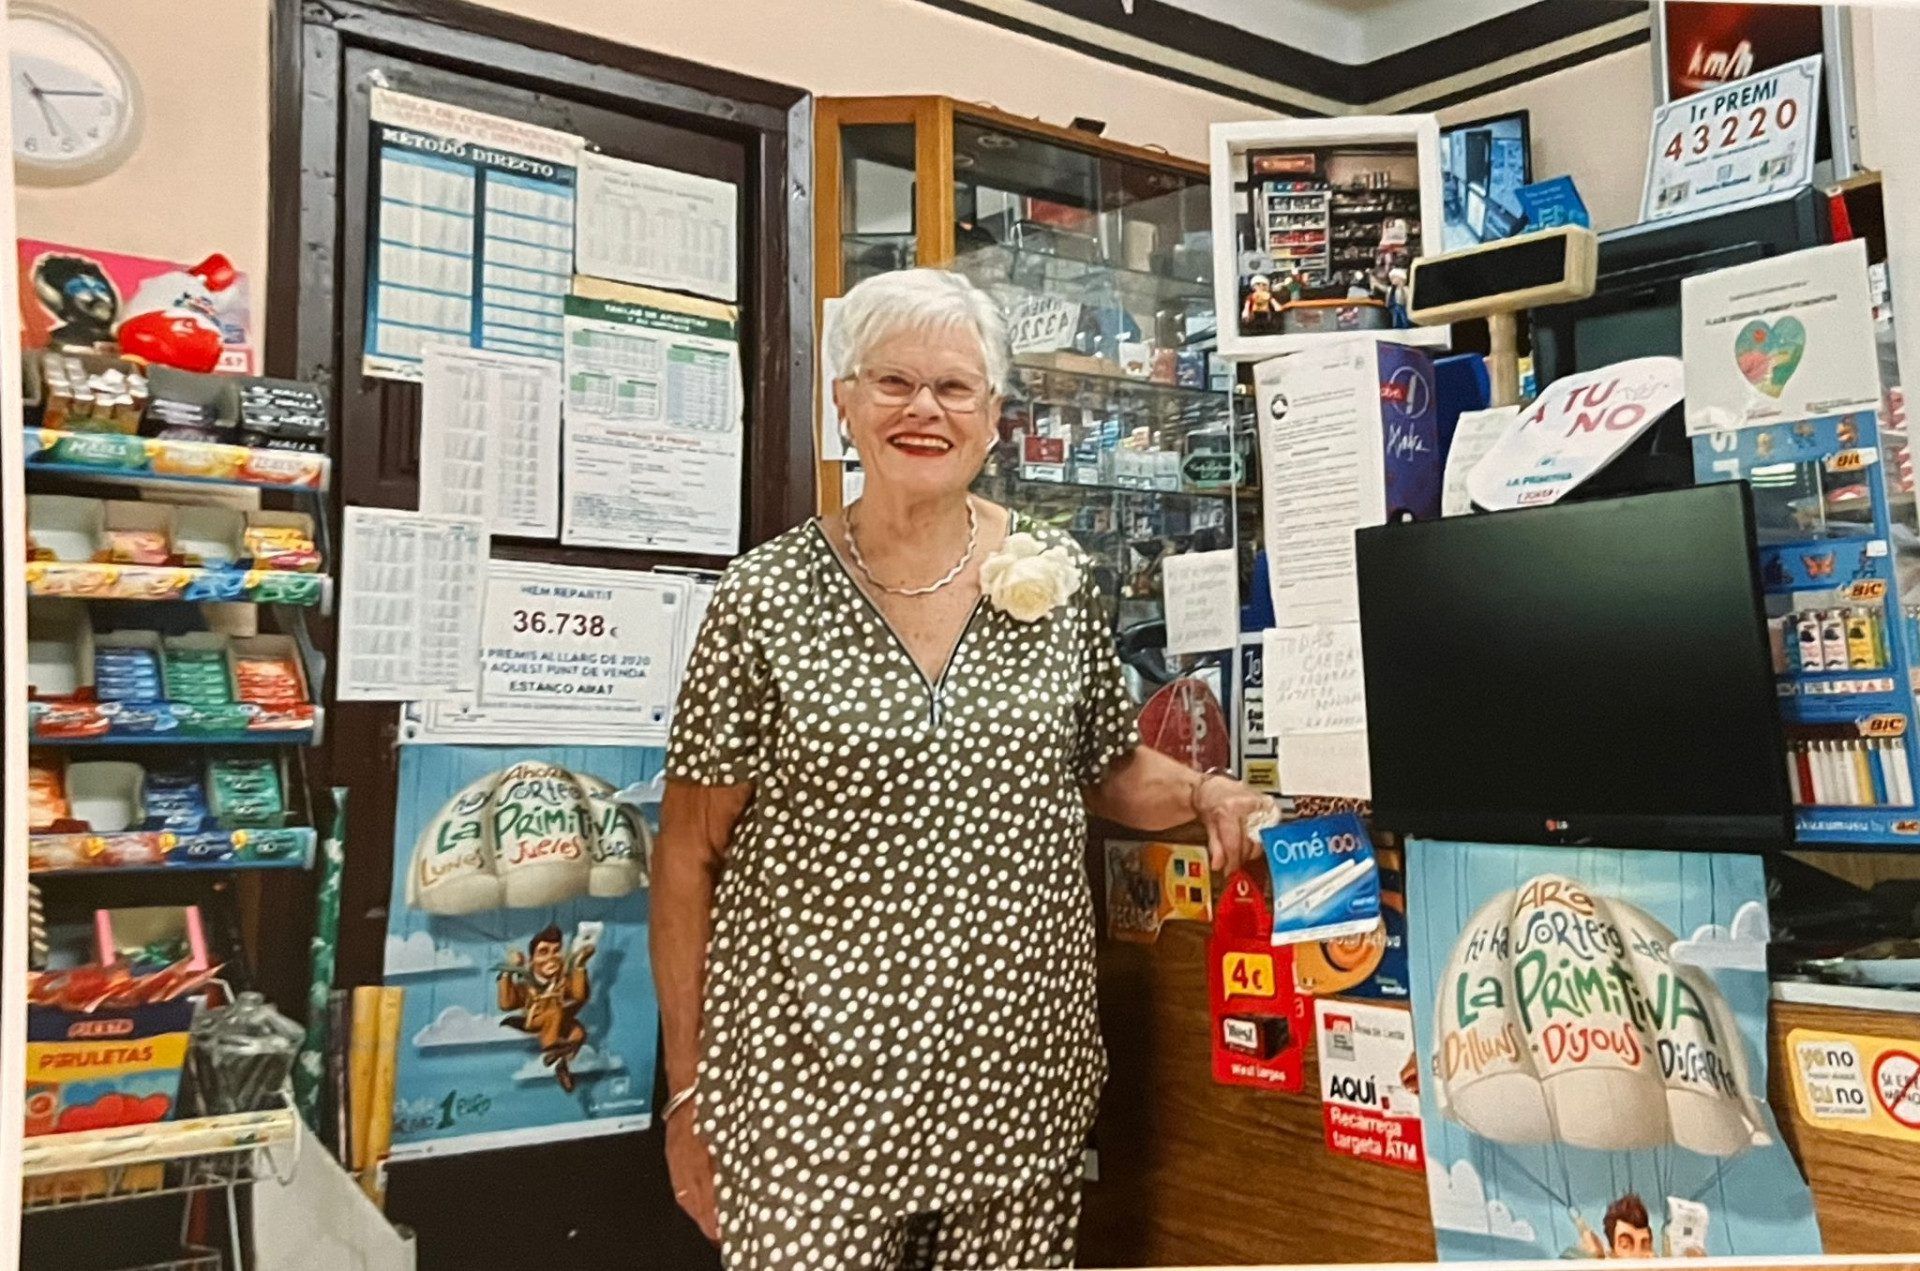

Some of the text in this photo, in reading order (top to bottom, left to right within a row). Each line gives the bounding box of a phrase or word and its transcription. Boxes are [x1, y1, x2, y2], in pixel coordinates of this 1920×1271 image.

[1714, 79, 1778, 115] PREMI
[1664, 98, 1797, 161] 43220
[472, 148, 554, 177] DIRECTO
[1564, 378, 1620, 414] TU
[1565, 403, 1646, 438] NO
[553, 587, 612, 600] REPARTIT
[1852, 582, 1882, 597] BIC
[513, 610, 605, 638] 36.738
[488, 649, 537, 661] PREMIS
[600, 654, 616, 665] DE
[546, 664, 577, 675] PUNT
[582, 665, 598, 676] DE
[603, 666, 646, 678] VENDA
[509, 681, 614, 695] ESTANCO AMAT
[1870, 718, 1902, 731] BIC
[436, 821, 481, 855] La
[1273, 831, 1324, 865] Omé
[1456, 971, 1504, 1028] La
[1543, 1022, 1640, 1066] Dijous
[1827, 1050, 1854, 1067] no
[1330, 1074, 1377, 1105] AQUÍ
[1836, 1087, 1864, 1105] no
[1385, 1140, 1417, 1162] ATM
